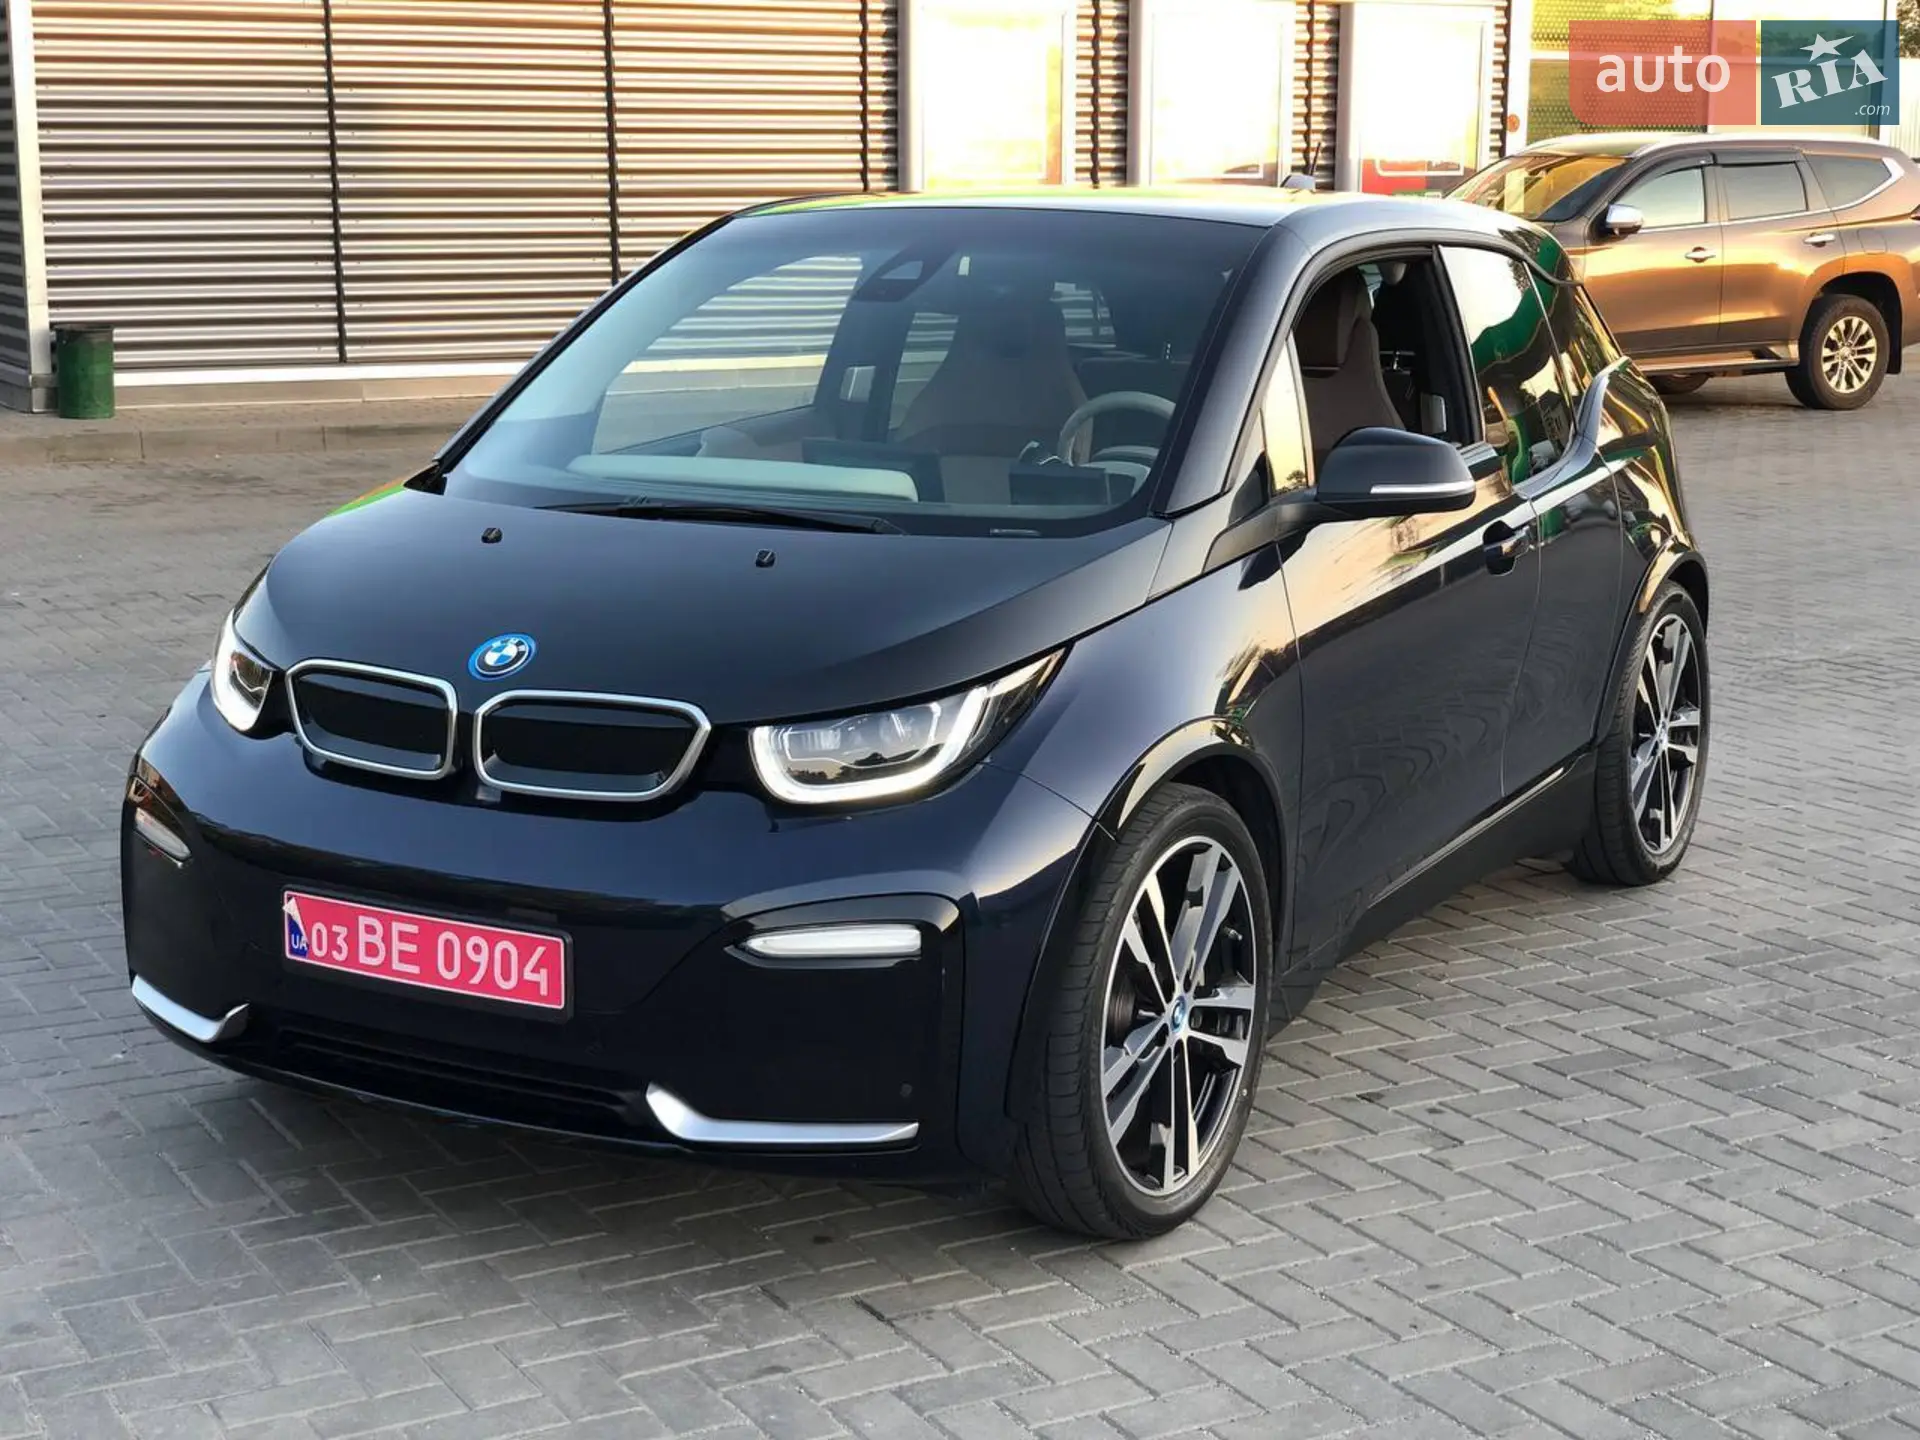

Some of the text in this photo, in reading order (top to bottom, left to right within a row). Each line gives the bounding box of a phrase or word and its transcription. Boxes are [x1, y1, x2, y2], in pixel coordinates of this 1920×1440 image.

[311, 915, 548, 996] 03 BE 0904
